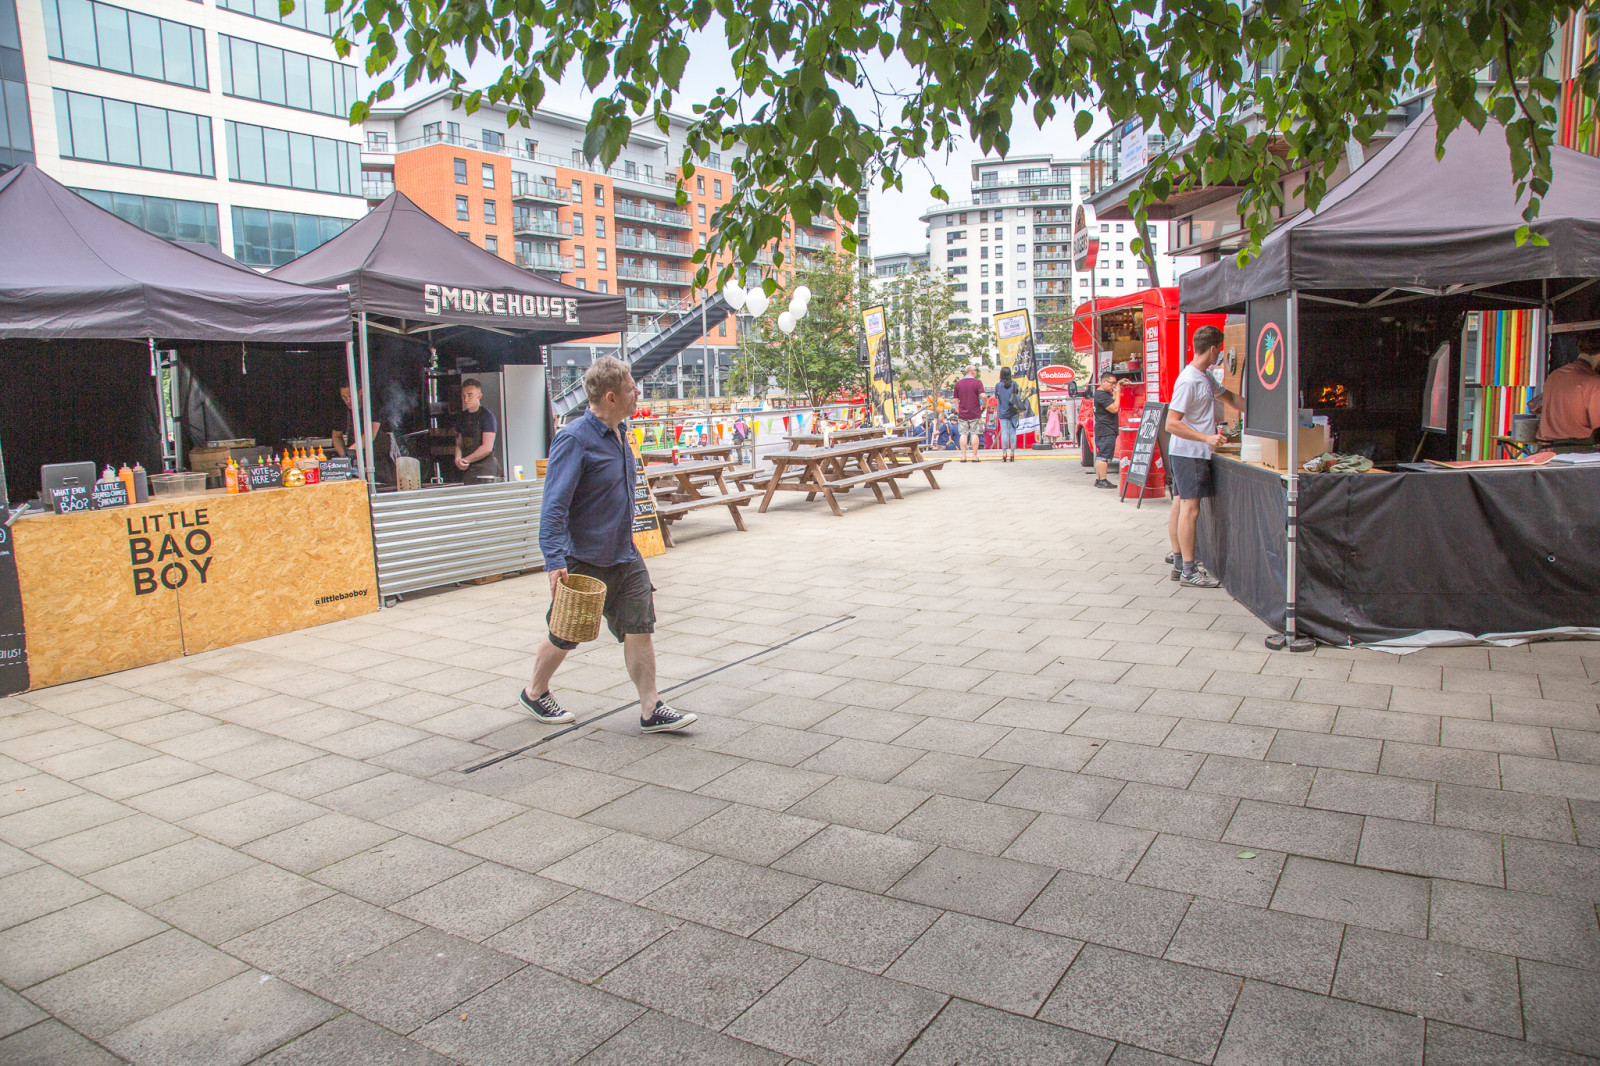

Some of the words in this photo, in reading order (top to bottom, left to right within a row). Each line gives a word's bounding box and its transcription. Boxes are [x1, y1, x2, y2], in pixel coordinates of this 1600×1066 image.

[424, 284, 580, 325] SMOKEHOUSE
[1146, 326, 1158, 339] MENU
[1007, 341, 1023, 352] EAT
[1040, 371, 1072, 379] Cocktails
[251, 467, 269, 476] VOTE
[251, 475, 270, 485] HERE
[52, 488, 70, 497] WHAT
[71, 486, 86, 495] EVEN
[94, 484, 99, 492] A
[101, 482, 120, 492] LITTLE
[60, 498, 89, 513] BAO?
[126, 508, 209, 536] LITTLE
[129, 528, 212, 566] BAO
[132, 556, 213, 596] BOY
[314, 588, 368, 606] @littlebaoboy
